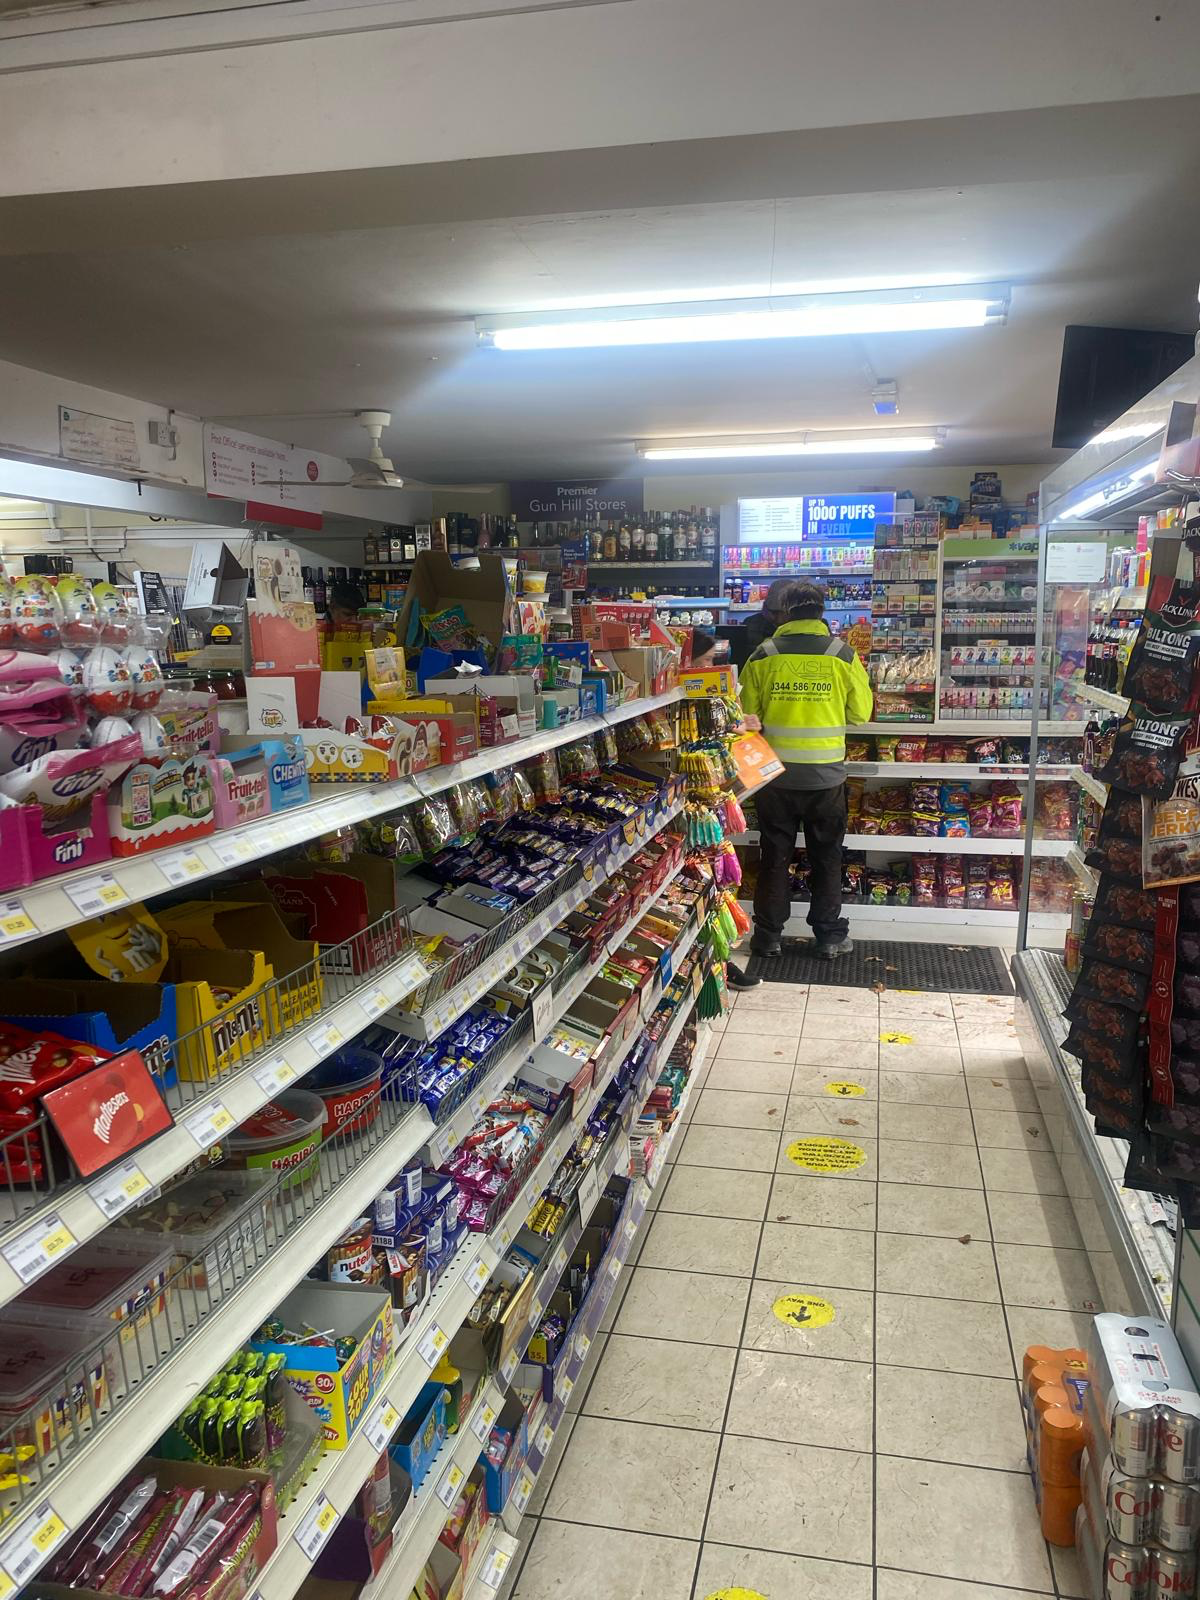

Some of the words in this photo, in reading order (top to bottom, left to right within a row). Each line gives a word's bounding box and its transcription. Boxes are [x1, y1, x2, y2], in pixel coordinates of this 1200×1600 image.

[557, 487, 598, 496] Premier
[529, 499, 557, 512] Gun
[561, 498, 582, 511] Hill
[585, 498, 626, 511] Stores
[840, 504, 876, 520] PUFFS
[807, 521, 818, 534] IN
[820, 522, 851, 536] EVERY
[1017, 542, 1039, 553] vap
[1146, 627, 1192, 649] BILTONG
[768, 660, 834, 673] LAVISH
[793, 682, 809, 691] 586
[811, 682, 832, 692] 7000
[1135, 718, 1180, 737] ILTONG
[272, 762, 306, 784] CHEWITS
[1175, 776, 1200, 800] WES
[1154, 807, 1199, 825] BEEF
[55, 838, 83, 862] Fini
[93, 1091, 131, 1145] Maltesers
[340, 1246, 373, 1273] nutell
[786, 1297, 805, 1305] WAY
[807, 1300, 825, 1308] ONE
